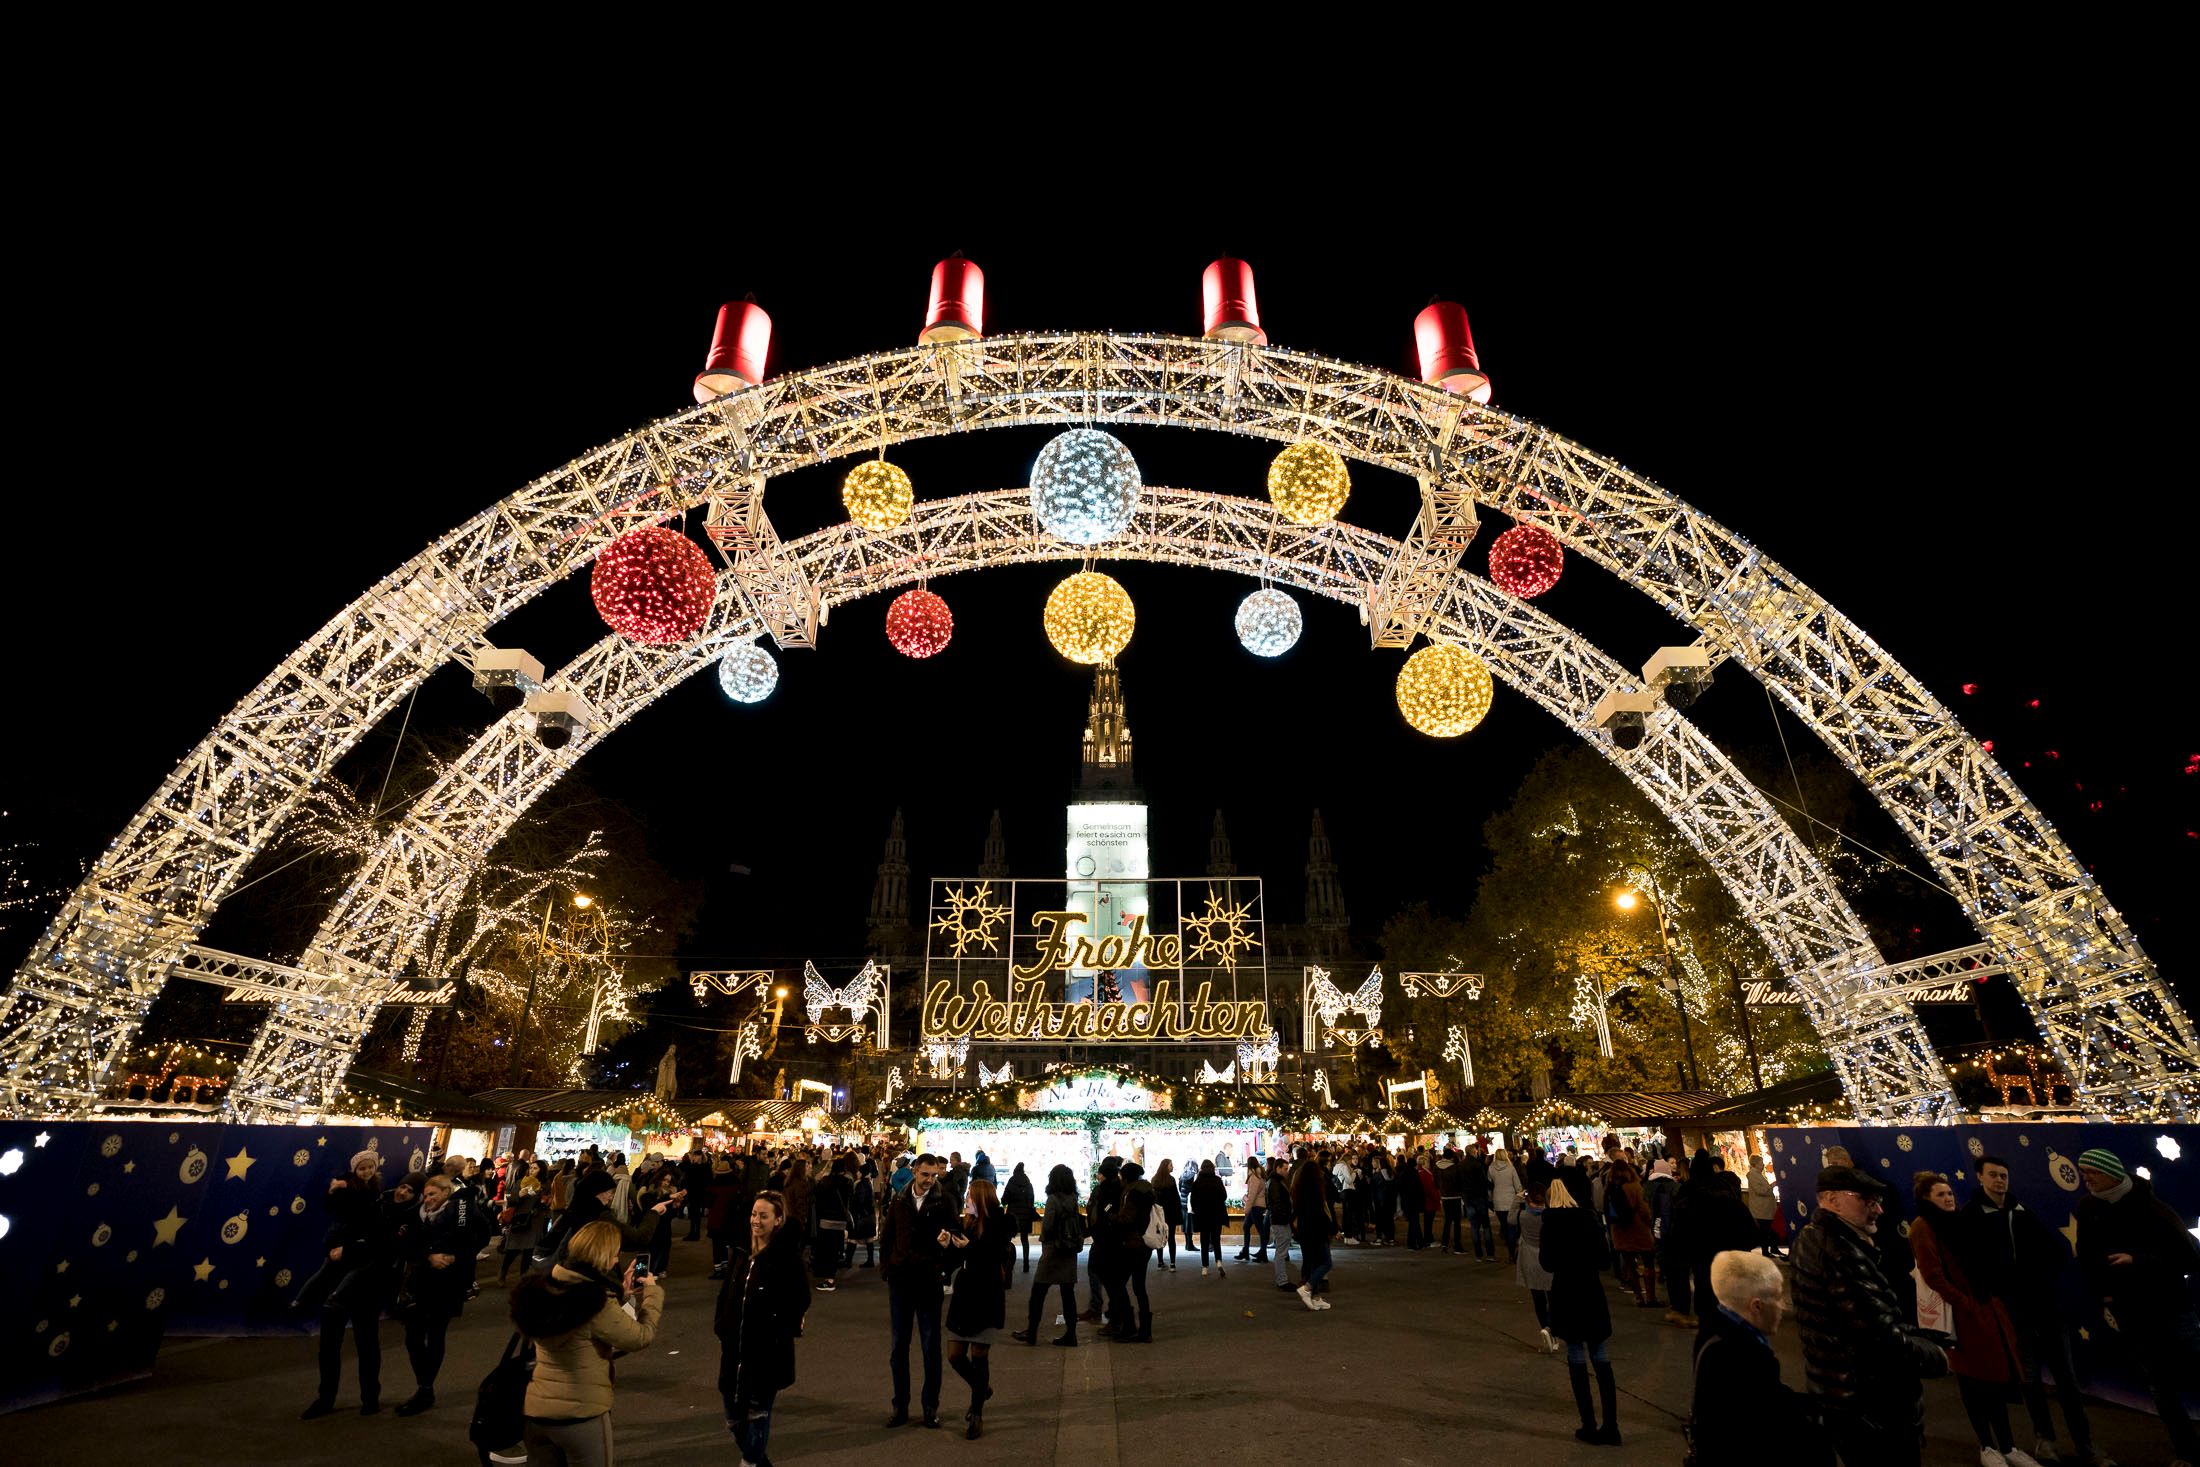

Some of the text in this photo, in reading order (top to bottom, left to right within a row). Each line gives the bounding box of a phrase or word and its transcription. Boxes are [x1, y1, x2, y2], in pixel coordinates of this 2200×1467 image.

[1086, 839, 1128, 847] schönsten
[1013, 911, 1182, 981] Frohe
[1740, 981, 1802, 1004] Wiene
[922, 979, 1267, 1039] Weihnachten
[1049, 1081, 1141, 1103] Nachkaze
